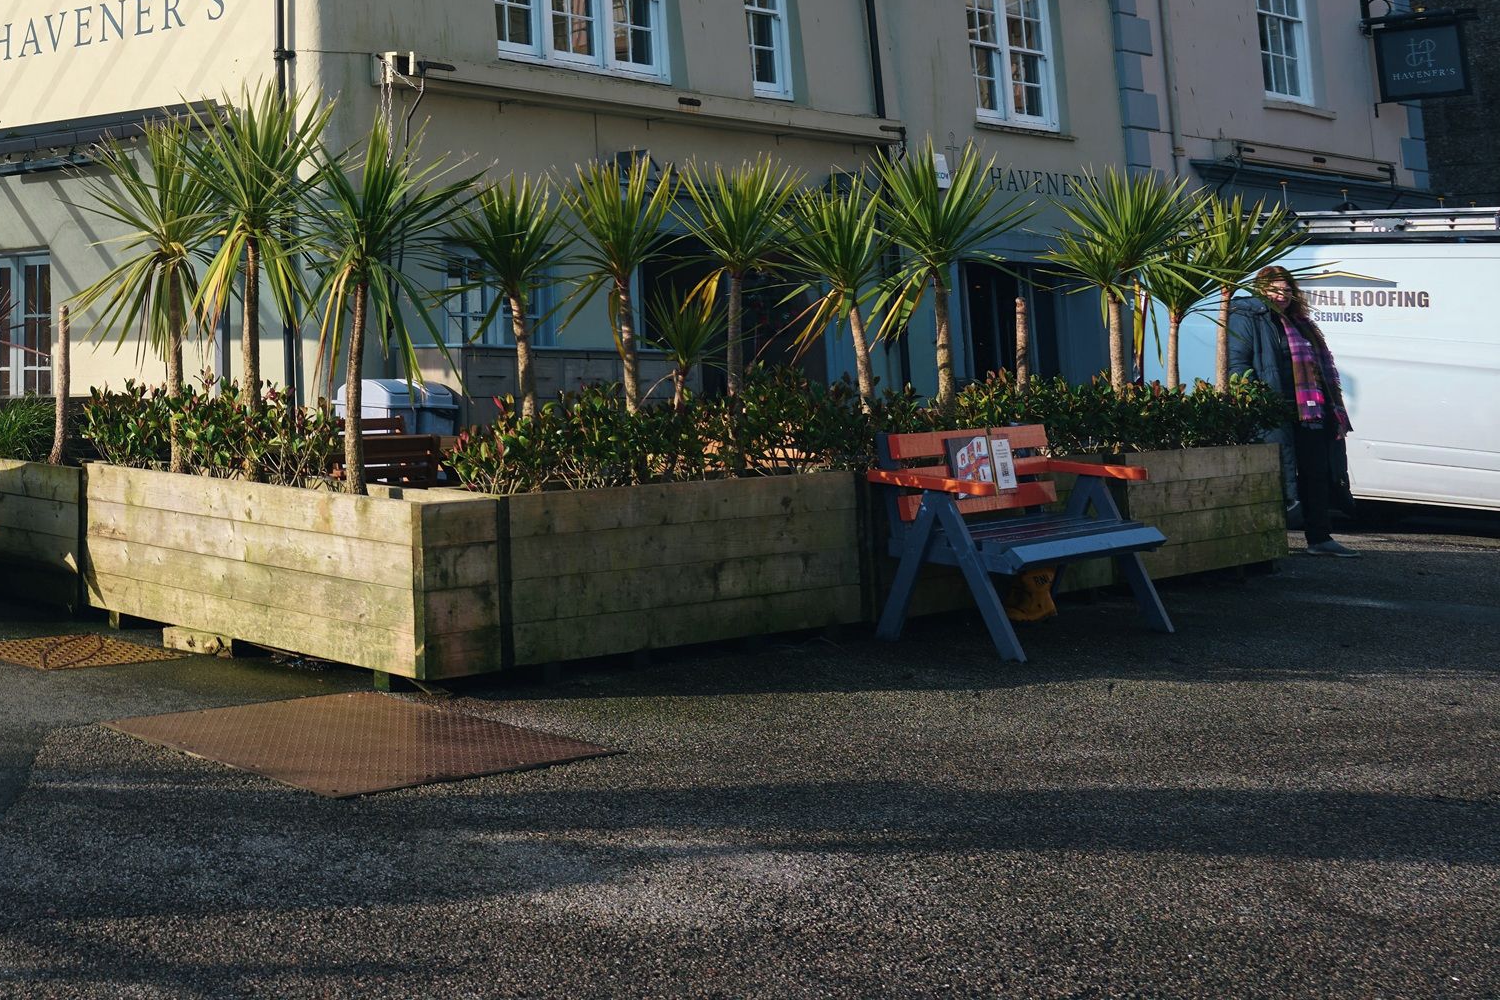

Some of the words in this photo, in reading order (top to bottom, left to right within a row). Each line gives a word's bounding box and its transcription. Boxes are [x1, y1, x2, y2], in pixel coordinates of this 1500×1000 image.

[1392, 68, 1456, 80] HAVENER'S
[1351, 290, 1430, 307] ROOFING
[1313, 312, 1364, 323] SERVICES
